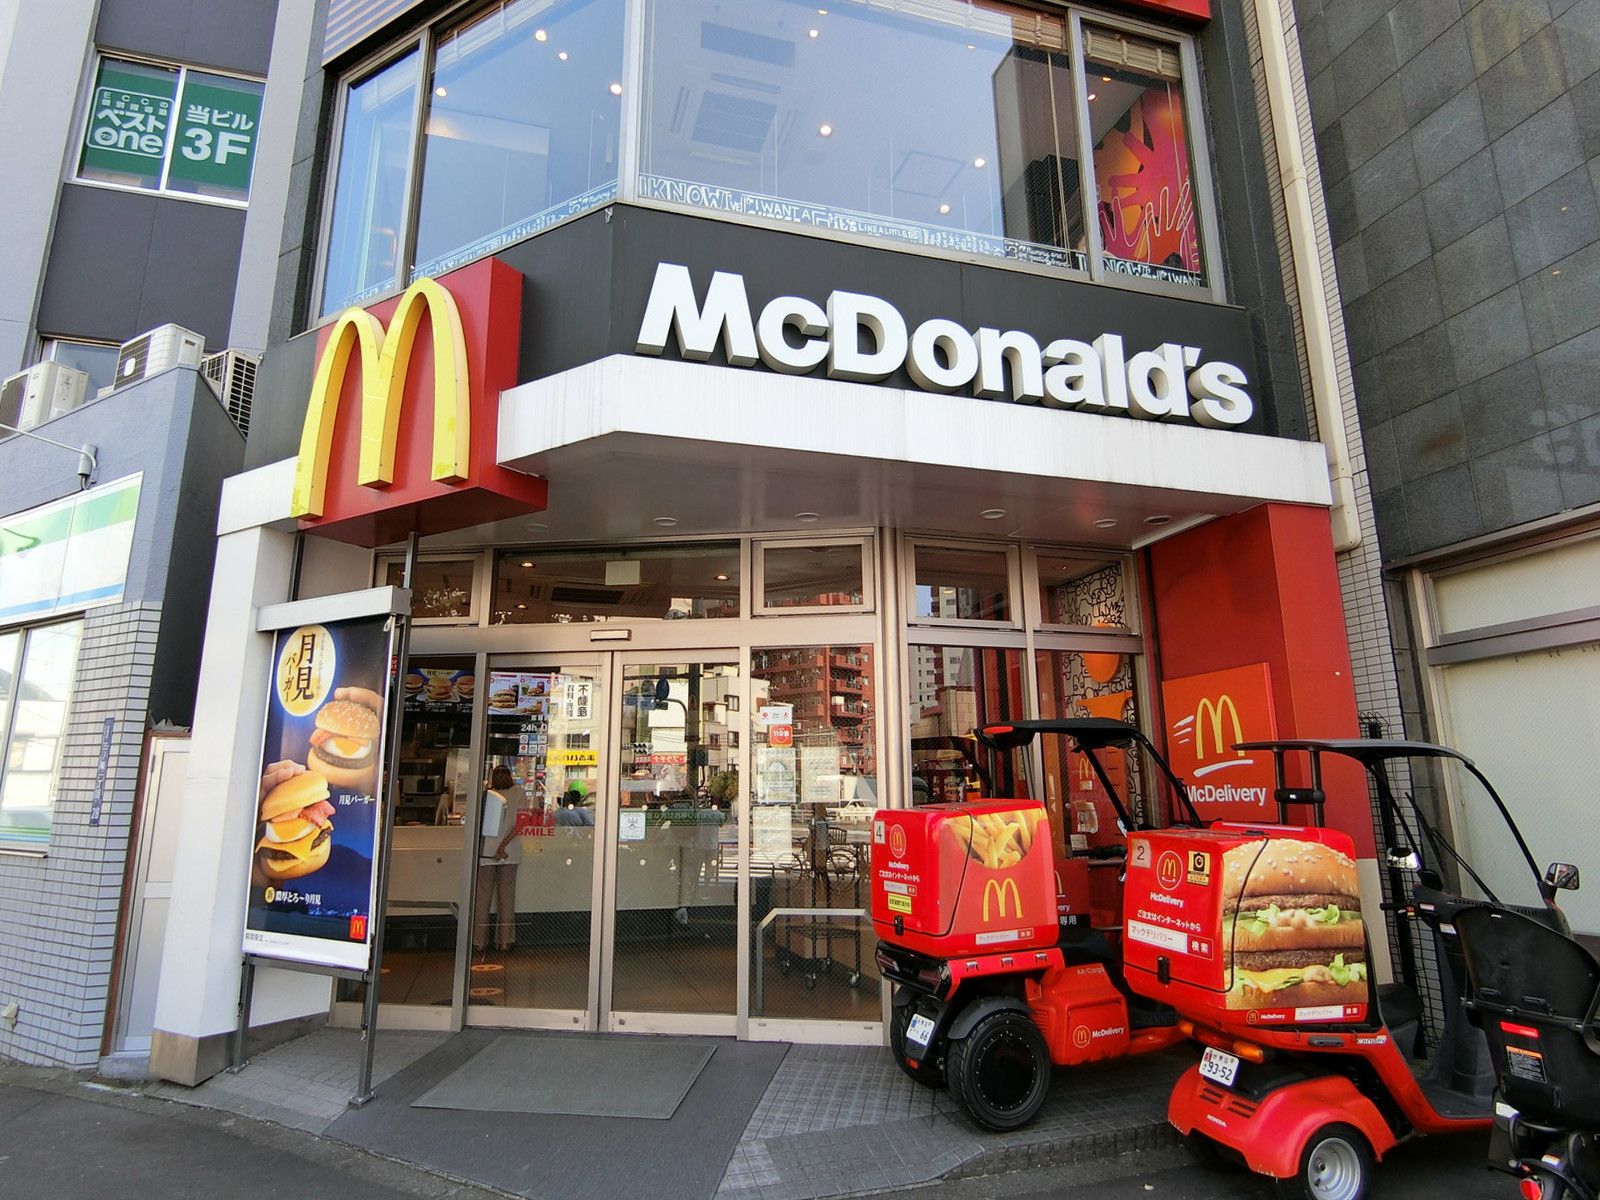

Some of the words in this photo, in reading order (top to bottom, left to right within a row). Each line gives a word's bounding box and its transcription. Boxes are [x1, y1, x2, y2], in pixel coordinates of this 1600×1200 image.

[97, 108, 167, 133] ベスト
[185, 104, 255, 131] 当ビル
[94, 126, 164, 154] one
[181, 127, 252, 166] 3F
[760, 201, 800, 218] WANT
[633, 261, 1255, 429] McDonald's
[291, 632, 317, 703] 月見
[282, 652, 298, 704] バーガー
[338, 794, 376, 805] 月見バーガー
[1186, 784, 1267, 806] McDelivery
[90, 807, 100, 819] 28
[516, 827, 555, 837] SMILE
[875, 825, 883, 840] 4
[1136, 845, 1145, 860] 2
[1150, 891, 1184, 908] McDelivery
[1137, 909, 1202, 932] ご注文はインターネットから
[1131, 925, 1174, 942] マックデリバリー
[1191, 940, 1209, 954] 検索
[1092, 1027, 1124, 1038] McDelivery
[1207, 1061, 1233, 1081] 93-52
